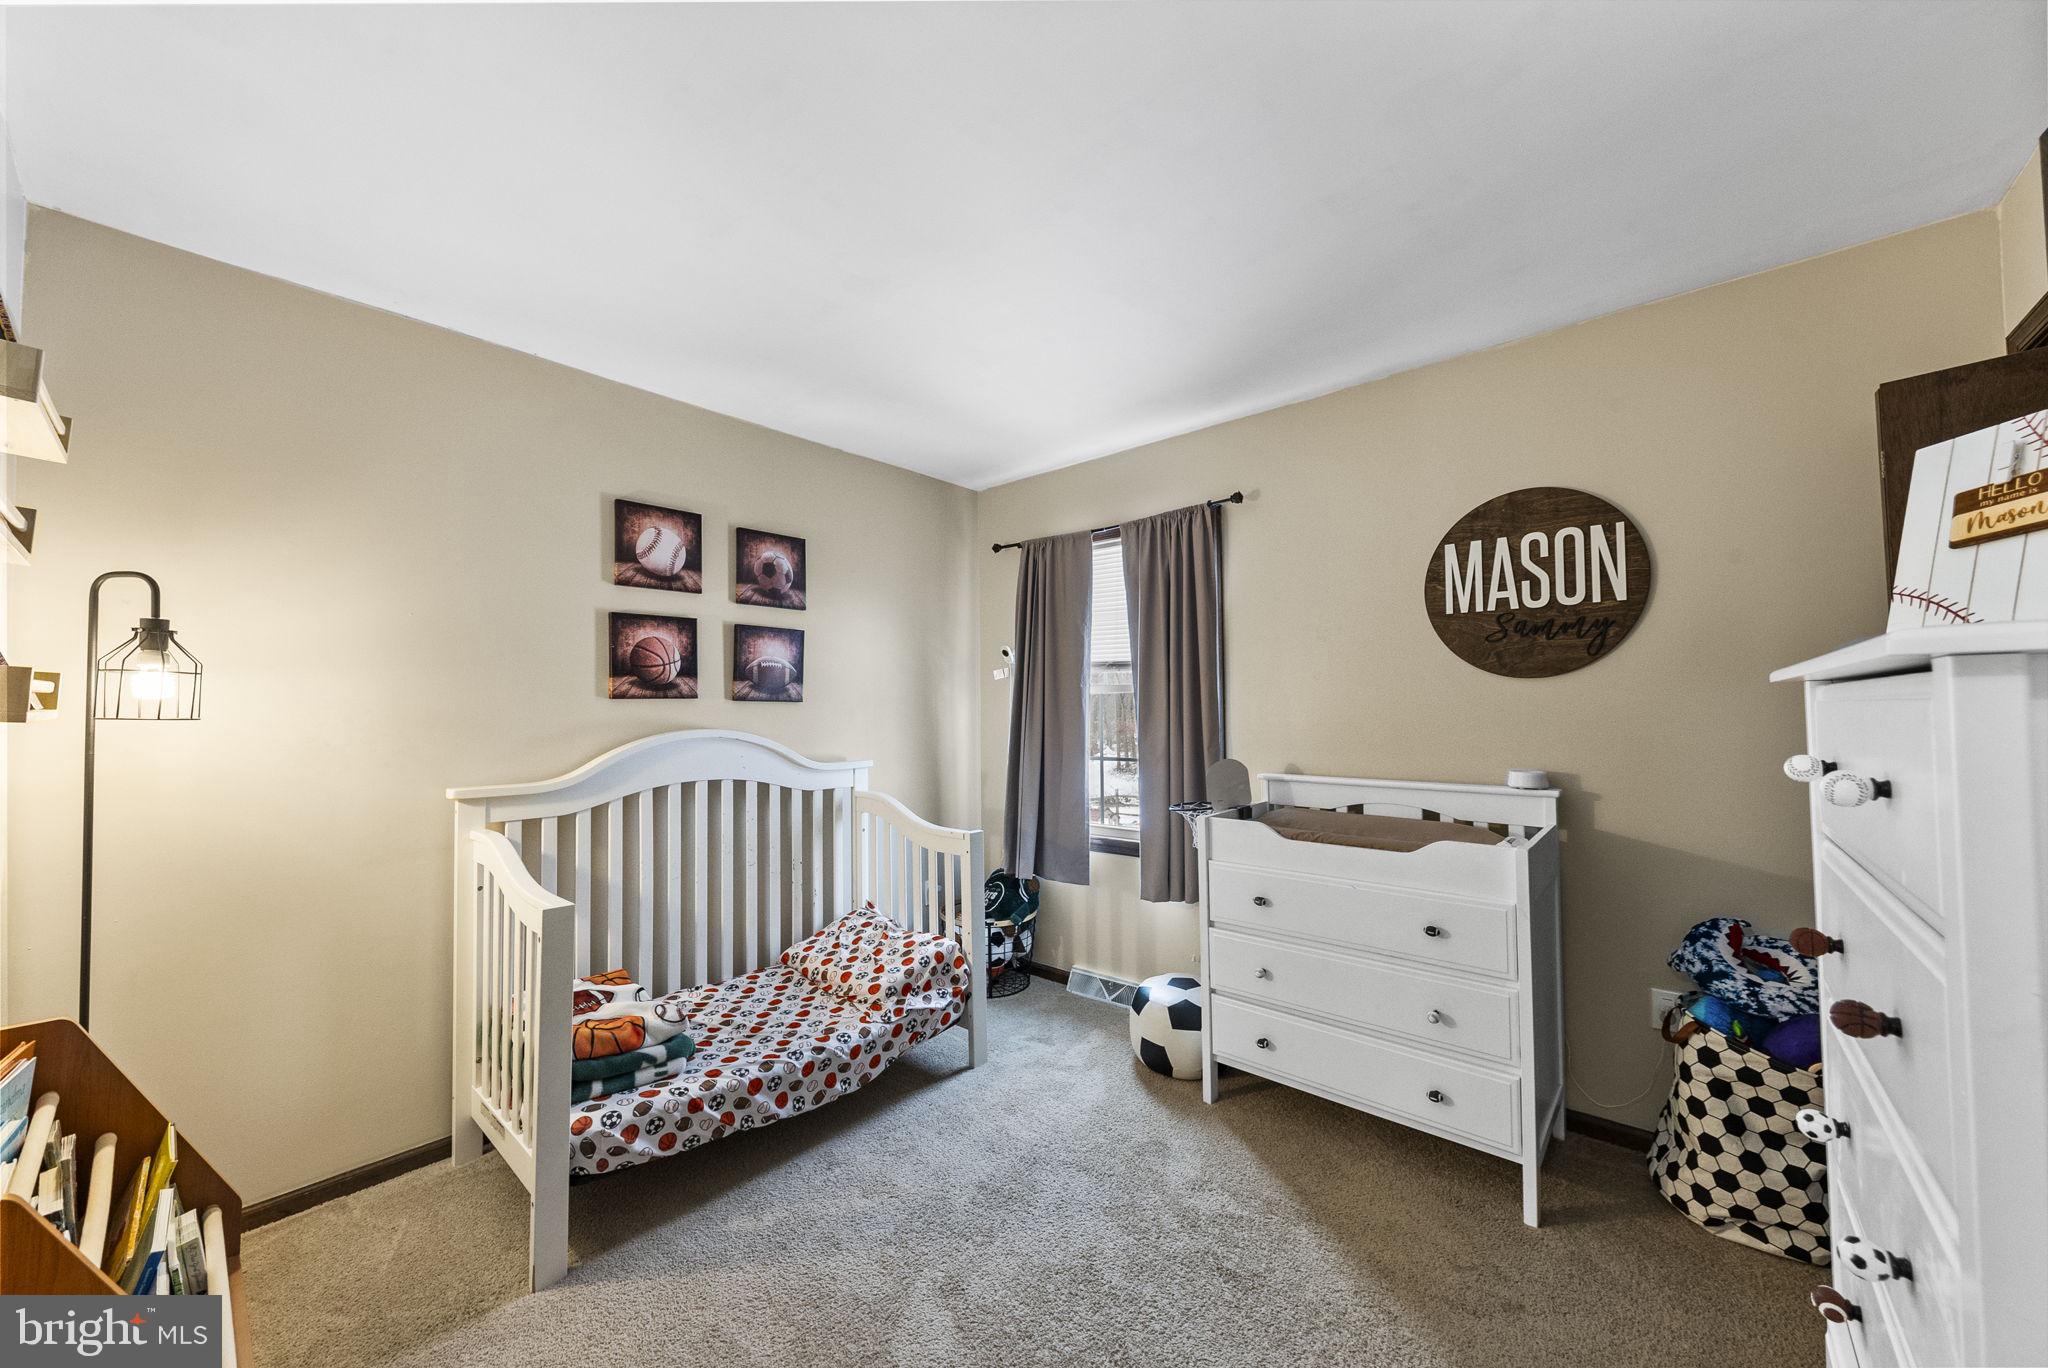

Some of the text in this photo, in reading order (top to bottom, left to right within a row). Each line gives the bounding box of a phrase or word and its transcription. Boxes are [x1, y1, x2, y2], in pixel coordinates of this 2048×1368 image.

[1978, 472, 2042, 500] HELLO
[1980, 486, 2038, 507] my name is
[1967, 500, 2048, 533] Mason
[1444, 521, 1628, 615] MASON
[1484, 612, 1617, 657] Sammy
